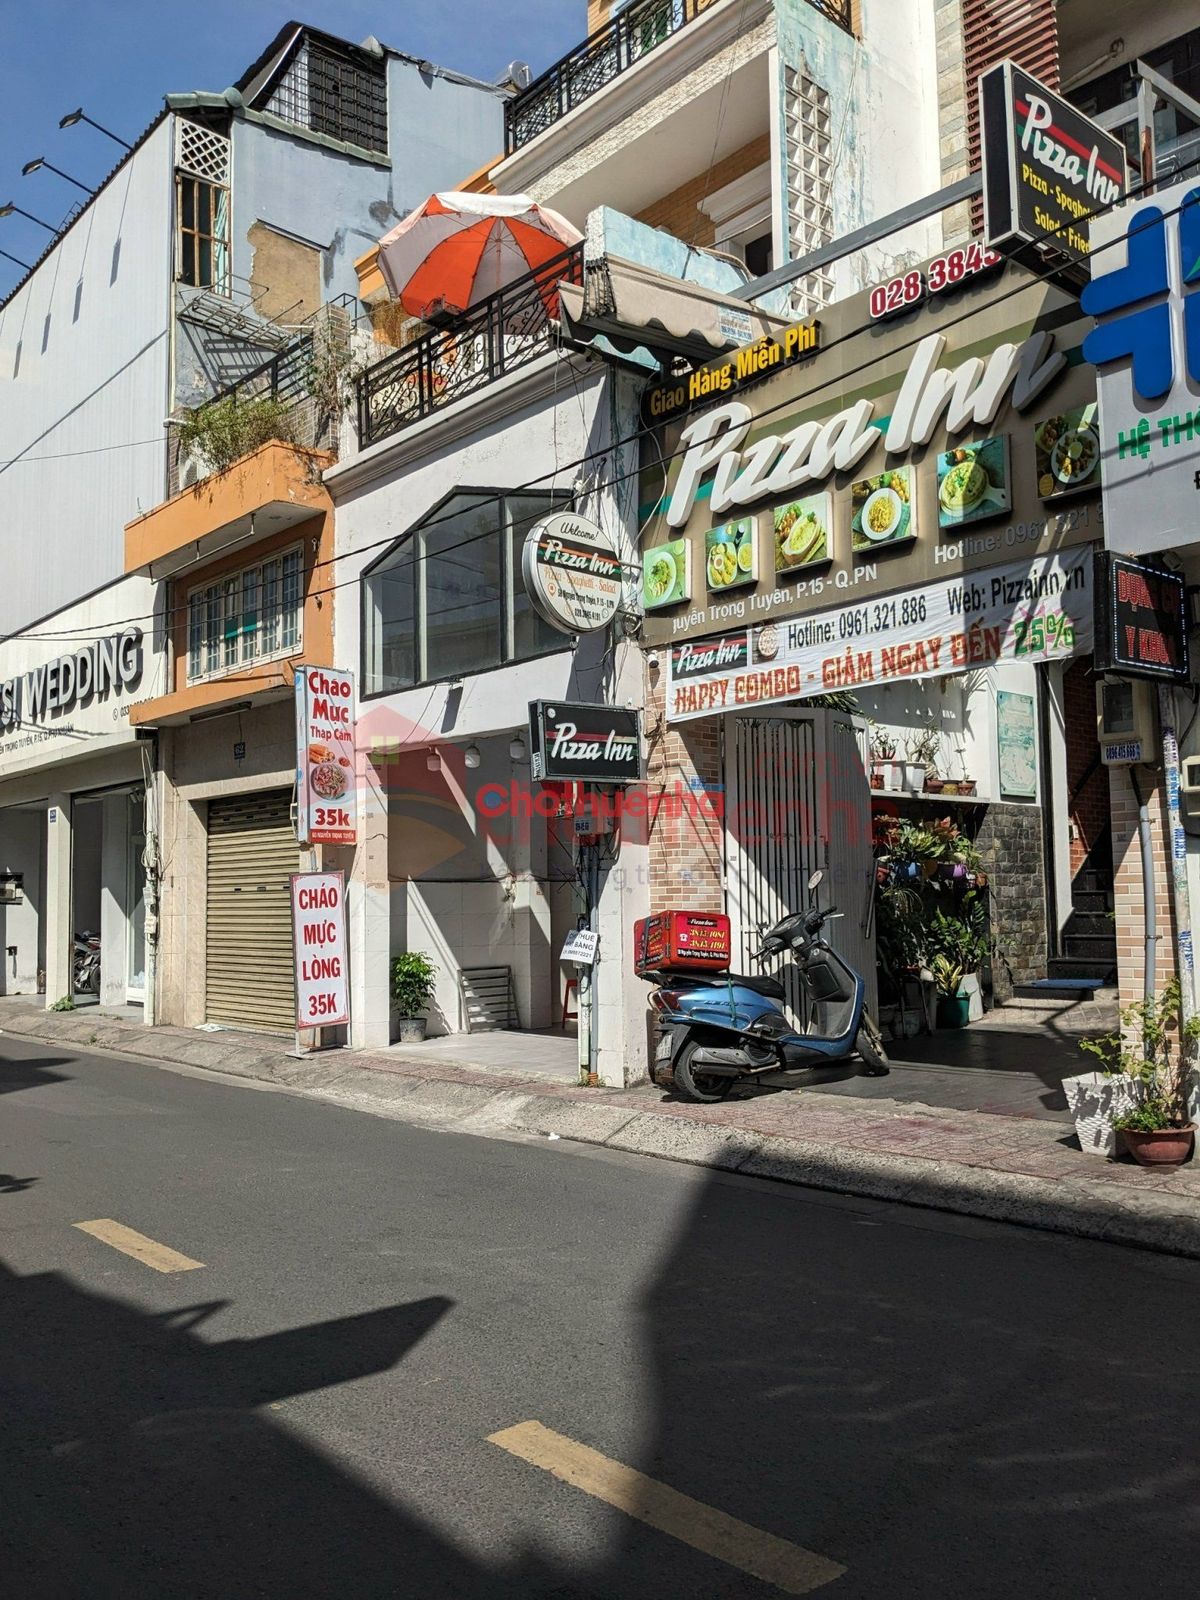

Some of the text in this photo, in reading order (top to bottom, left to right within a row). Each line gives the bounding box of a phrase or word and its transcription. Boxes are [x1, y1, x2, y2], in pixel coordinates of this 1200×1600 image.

[1021, 93, 1121, 207] Pizza Inn
[1022, 164, 1048, 197] Pizza
[869, 270, 921, 319] 028
[650, 386, 685, 416] Giao
[689, 362, 732, 401] Hàng
[736, 336, 780, 380] Miễn
[785, 320, 818, 359] Phí
[667, 332, 1067, 528] Pizza Inn
[1118, 418, 1150, 460] HỆ
[561, 522, 598, 541] Welcome!
[934, 536, 1000, 565] Hotline:
[1005, 516, 1049, 546] 0961
[544, 539, 616, 575] Pizza Inn
[709, 600, 745, 621] Trọng
[797, 577, 823, 598] P.15
[835, 563, 877, 589] Q.PN
[788, 565, 1085, 649] Hotline: 0961.321.886 Web: Pizzainn.vn
[23, 627, 143, 718] WEDDING
[674, 678, 729, 714] HAPPY
[734, 665, 800, 704] COMBO
[822, 646, 874, 689] GIẢM
[881, 636, 943, 676] NGAY
[950, 617, 1002, 666] ĐẾN
[1013, 612, 1076, 656] 25%
[677, 638, 742, 674] Pizza Inn
[313, 697, 349, 724] Mực
[551, 722, 634, 762] Pizza Inn
[315, 808, 350, 827] 35k
[299, 882, 338, 910] CHÁO
[303, 919, 337, 948] MỰC
[302, 954, 341, 981] LÒNG
[308, 992, 337, 1017] 35K
